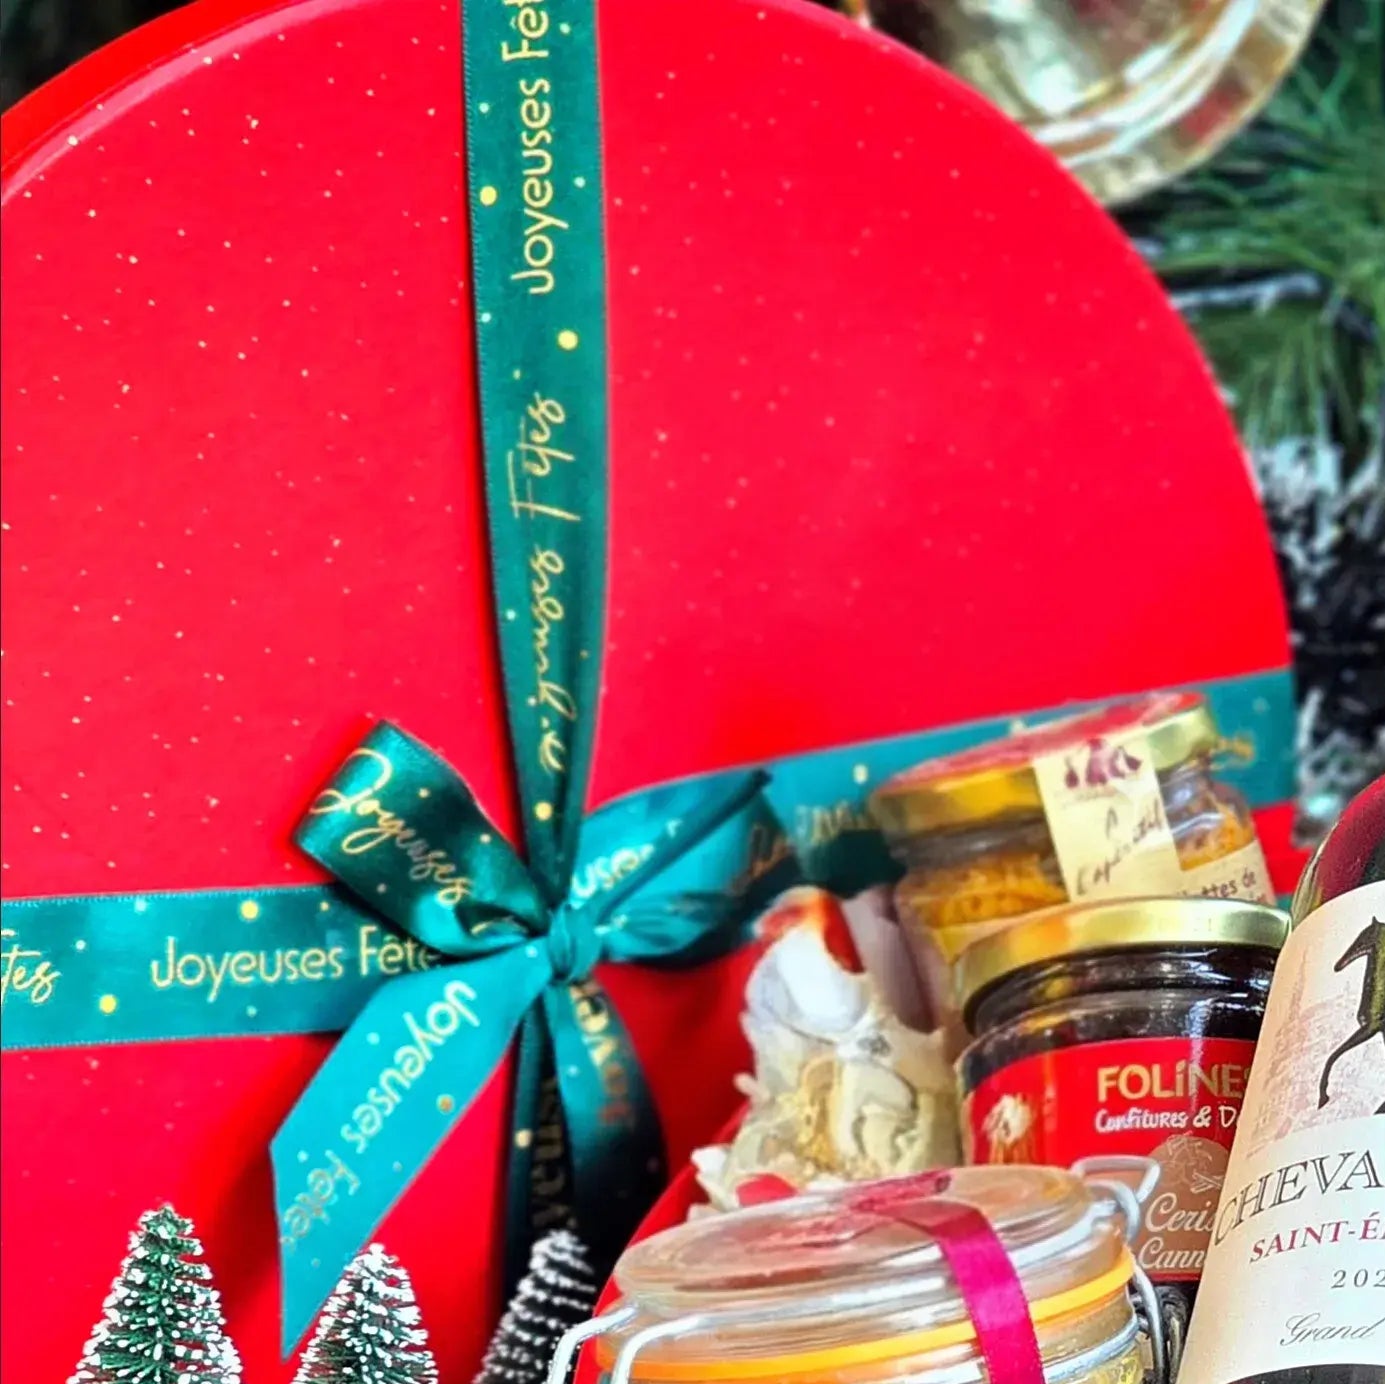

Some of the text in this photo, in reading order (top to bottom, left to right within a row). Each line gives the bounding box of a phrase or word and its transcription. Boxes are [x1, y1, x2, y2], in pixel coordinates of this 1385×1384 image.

[502, 0, 569, 294] Joyeuses Fê
[0, 930, 62, 1004] tes
[151, 925, 442, 1003] Joyeuses Fête
[340, 980, 480, 1154] Joyeuses
[1137, 1236, 1205, 1270] Cann
[1279, 1312, 1385, 1347] Grand
